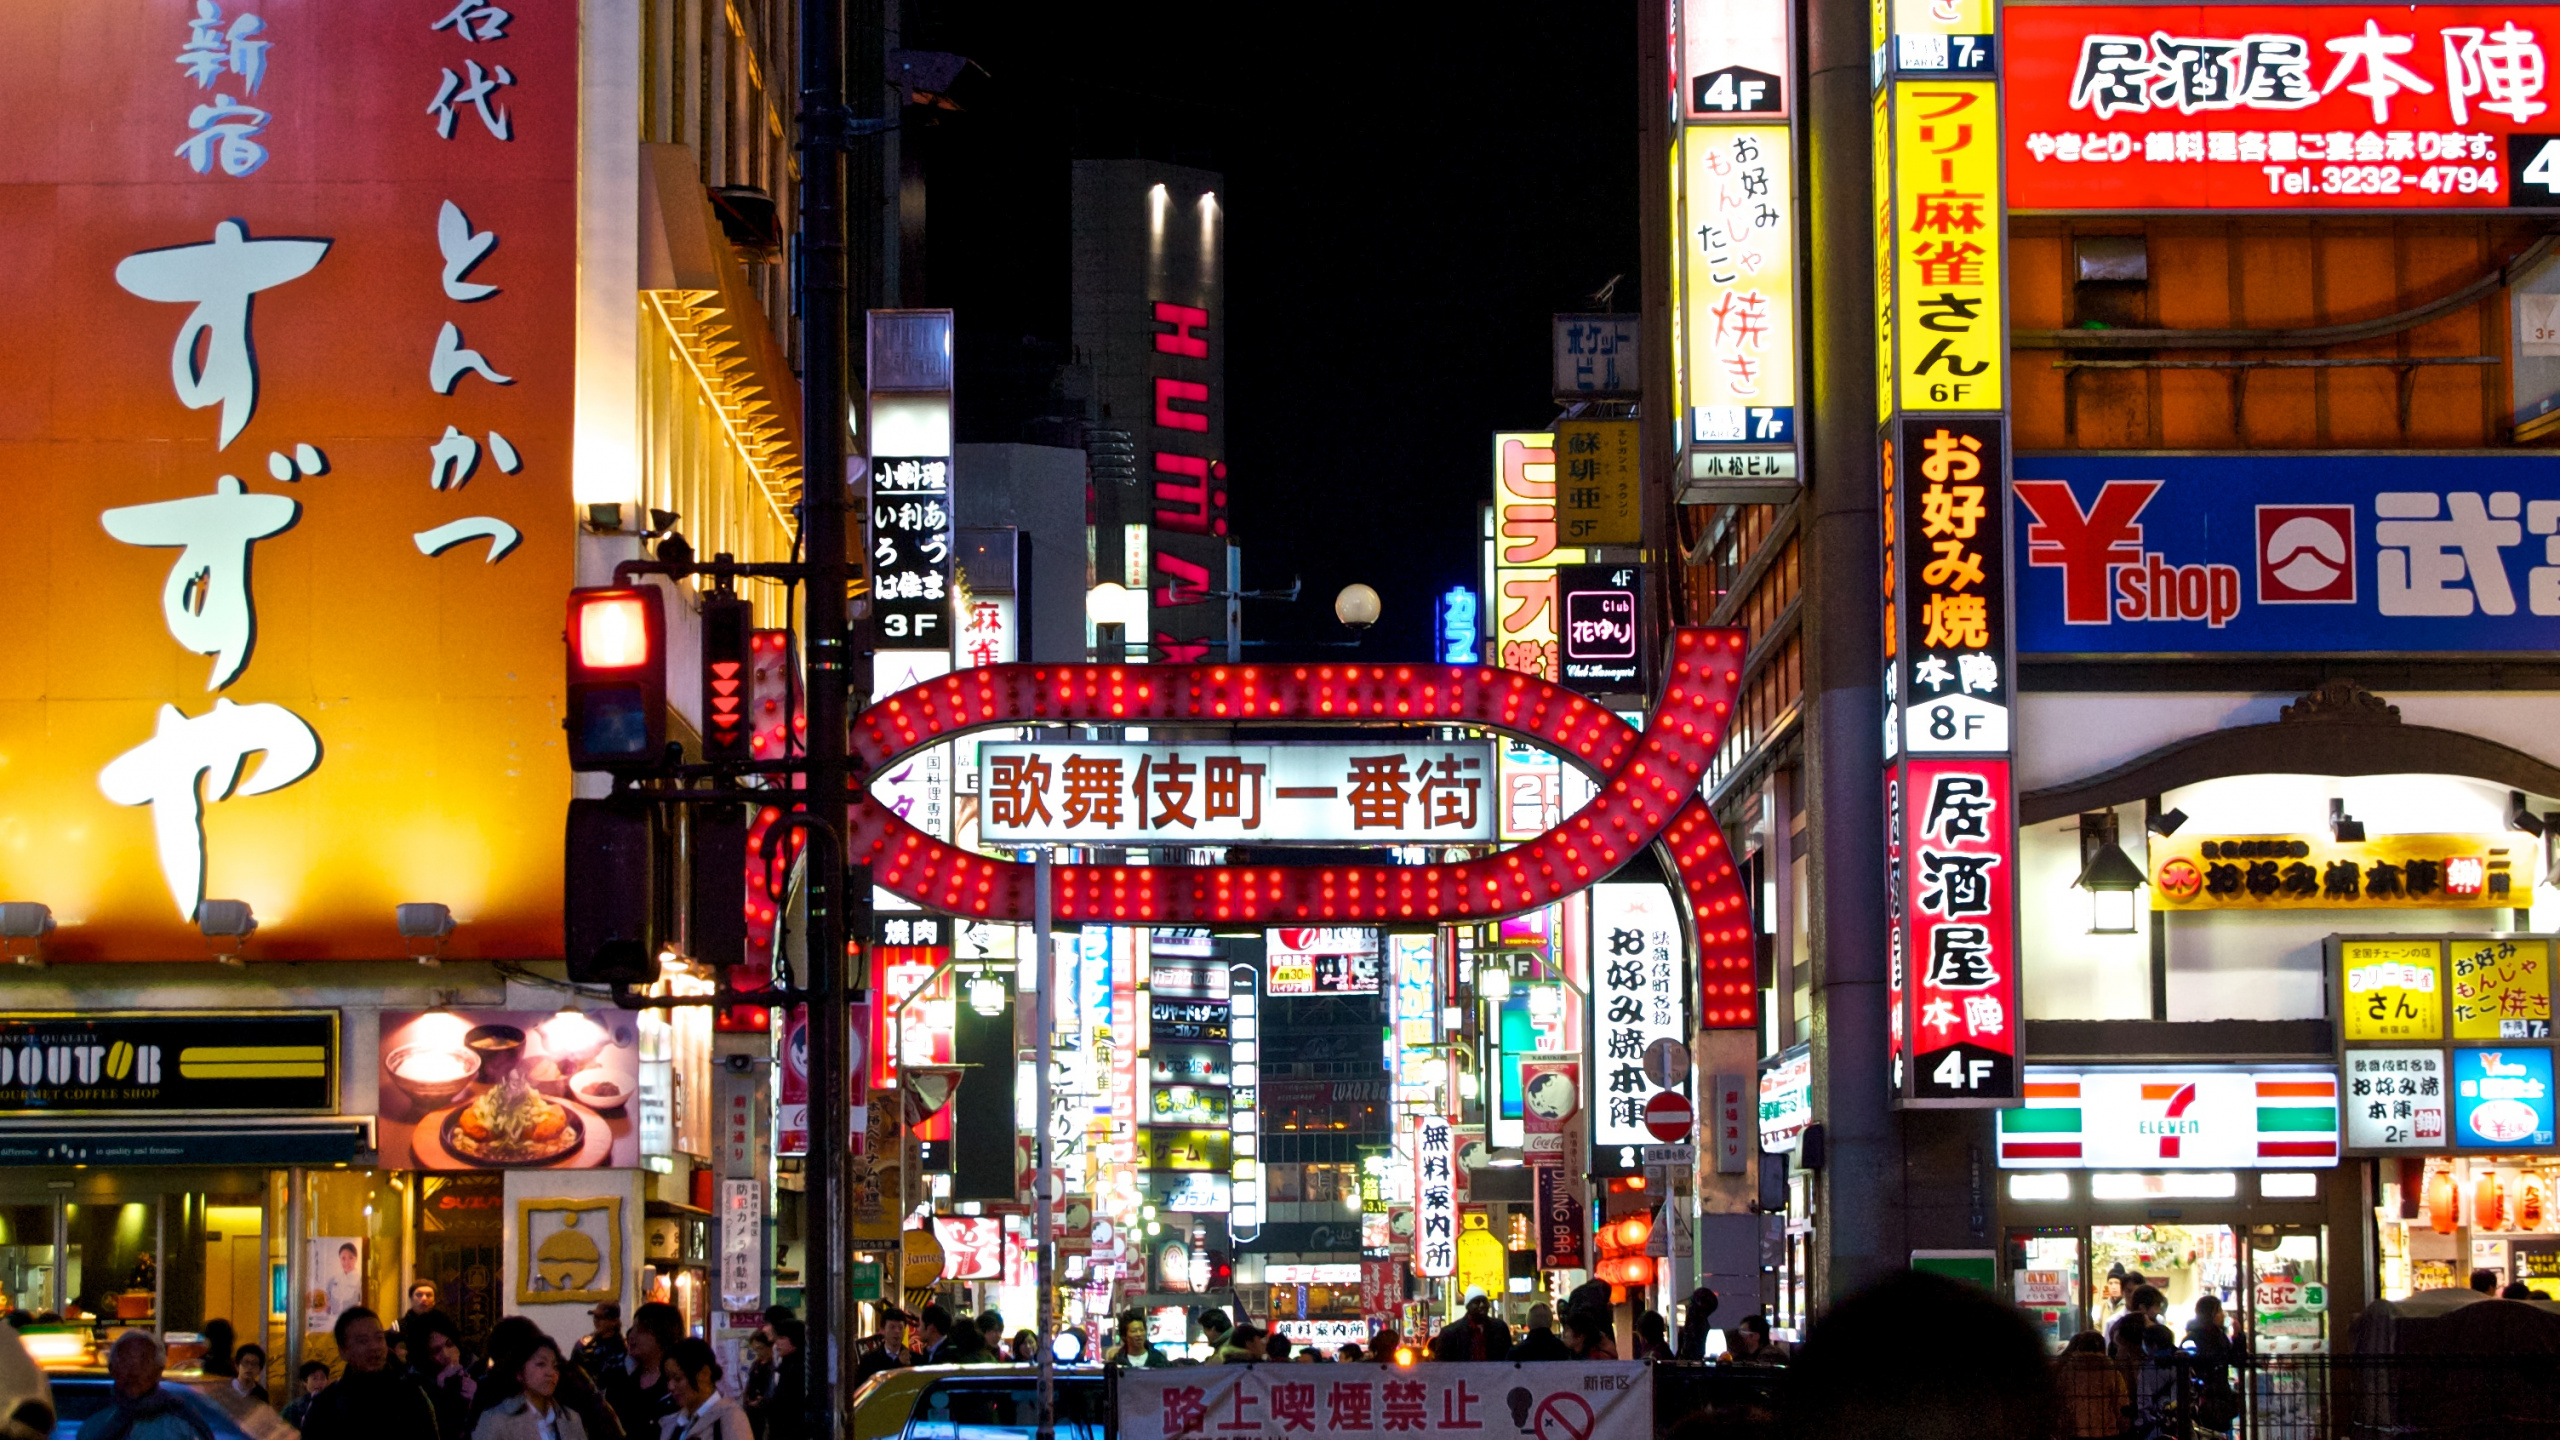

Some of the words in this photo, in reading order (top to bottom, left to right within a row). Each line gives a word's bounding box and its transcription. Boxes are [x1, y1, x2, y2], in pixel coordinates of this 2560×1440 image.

[1952, 36, 1986, 68] 7F
[175, 0, 272, 177] 新宿
[2069, 18, 2549, 126] 居酒屋本陣
[1704, 73, 1766, 111] 4F
[1733, 137, 1781, 230] お好み
[2262, 165, 2499, 194] Tel.3232-4794
[1705, 150, 1763, 274] もんじゃ
[1910, 91, 1991, 377] フリー麻雀さん
[1566, 322, 1631, 356] ポケット
[2535, 326, 2556, 340] 3F
[413, 198, 523, 565] とんかつ
[1576, 357, 1620, 392] ビル
[1929, 382, 1973, 403] 6F
[1751, 407, 1784, 439] 7F
[874, 460, 947, 491] 小料理
[1707, 455, 1781, 476] 小松ビル
[1568, 518, 1599, 538] 5F
[1921, 428, 1990, 650] お好み焼
[874, 504, 898, 601] いろは
[920, 500, 947, 600] あづま
[99, 214, 336, 926] すずや
[1610, 569, 1632, 587] 4F
[1602, 599, 1630, 613] Club
[884, 613, 938, 637] 3F
[1571, 619, 1632, 645] 花ゆり
[1915, 651, 1999, 694] 本陣
[1929, 704, 1986, 741] 8F
[926, 744, 941, 841] 国料理専門
[989, 752, 1482, 831] 歌舞伎町一番街
[1917, 772, 2001, 991] 居酒屋
[884, 919, 938, 946] 焼肉
[2352, 947, 2432, 959] 全国チェーンの店
[2454, 942, 2518, 977] お好み
[2456, 959, 2538, 999] もんじゃ
[1921, 994, 2004, 1037] 本陣
[2367, 992, 2419, 1021] さん
[2454, 986, 2551, 1023] たこ焼き
[1606, 926, 1647, 1129] お好み焼本陣
[2530, 1020, 2549, 1037] 7F
[1932, 1051, 1994, 1089] 4F
[2352, 1076, 2441, 1097] お好み焼
[64, 1089, 119, 1100] COFFEE
[122, 1088, 161, 1099] SHOP
[2367, 1099, 2413, 1120] 本陣
[2384, 1124, 2409, 1143] 2F
[1422, 1124, 1451, 1268] 無料案内所
[735, 1183, 748, 1293] 防犯カメラ作動中
[1553, 1225, 1572, 1254] BAR
[2256, 1285, 2298, 1305] たばこ
[2304, 1285, 2324, 1305] 酒
[1583, 1374, 1631, 1392] 新宿区
[1162, 1379, 1483, 1434] 路上喫煙禁止
